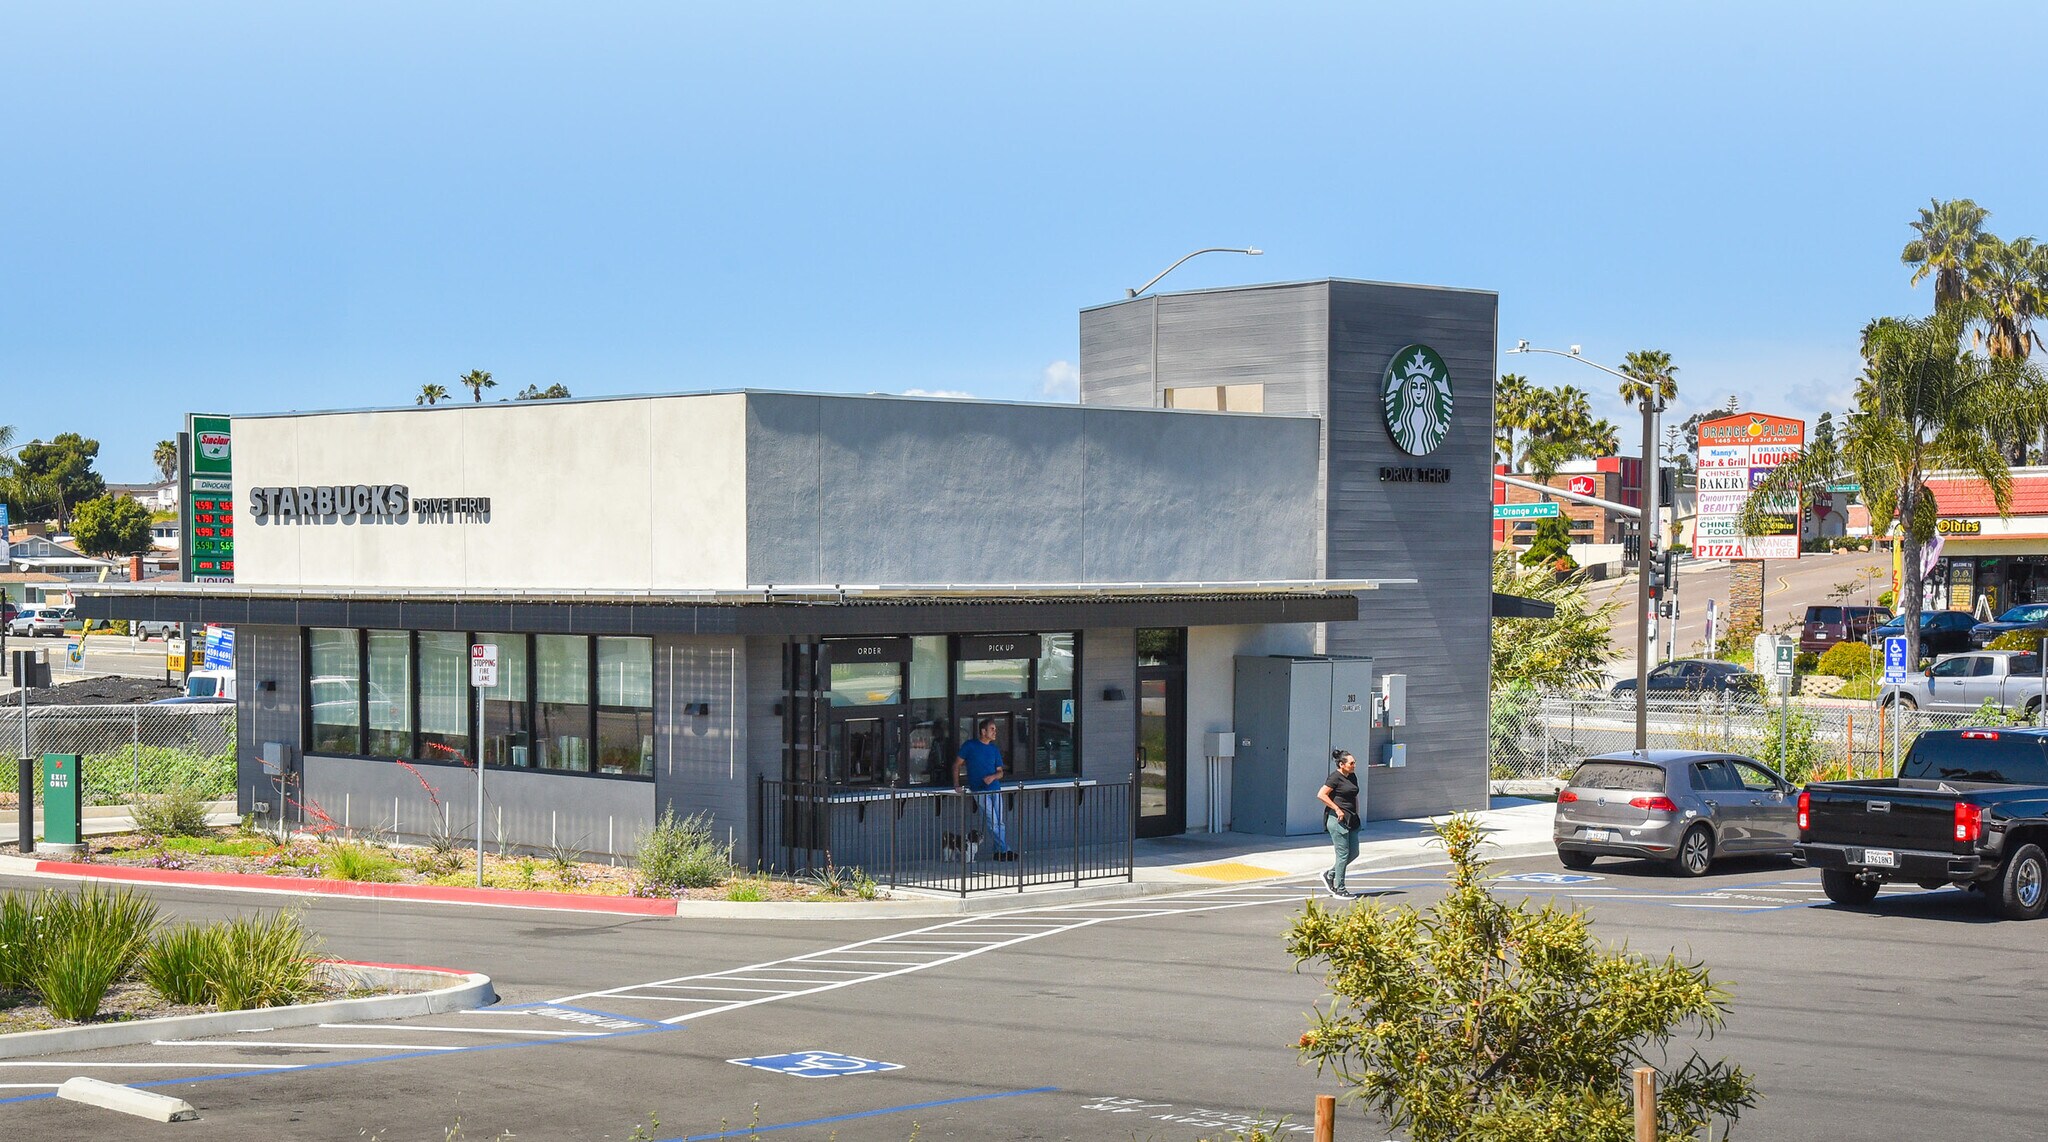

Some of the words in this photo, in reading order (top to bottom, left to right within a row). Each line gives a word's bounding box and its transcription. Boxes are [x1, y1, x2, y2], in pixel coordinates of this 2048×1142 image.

[1702, 426, 1748, 438] ORANGE
[1763, 424, 1799, 436] PLAZA
[201, 434, 230, 446] Sinclair
[1710, 449, 1737, 457] Manny's
[1699, 459, 1714, 467] Bar
[1718, 458, 1724, 466] &
[1727, 457, 1746, 466] Grill
[1422, 468, 1451, 483] THRU
[1700, 477, 1746, 489] BAKERY
[249, 484, 409, 516] STARBUCKS
[412, 497, 450, 514] DRIVE
[451, 497, 490, 514] THRU
[1503, 507, 1530, 516] Orange
[1533, 506, 1548, 514] Ave
[1938, 519, 1980, 534] Oldies
[1698, 545, 1744, 557] PIZZA
[474, 646, 483, 656] NO
[857, 647, 881, 655] ORDER
[988, 644, 1004, 652] PICK
[473, 659, 495, 667] STOPPING
[1064, 702, 1071, 714] A
